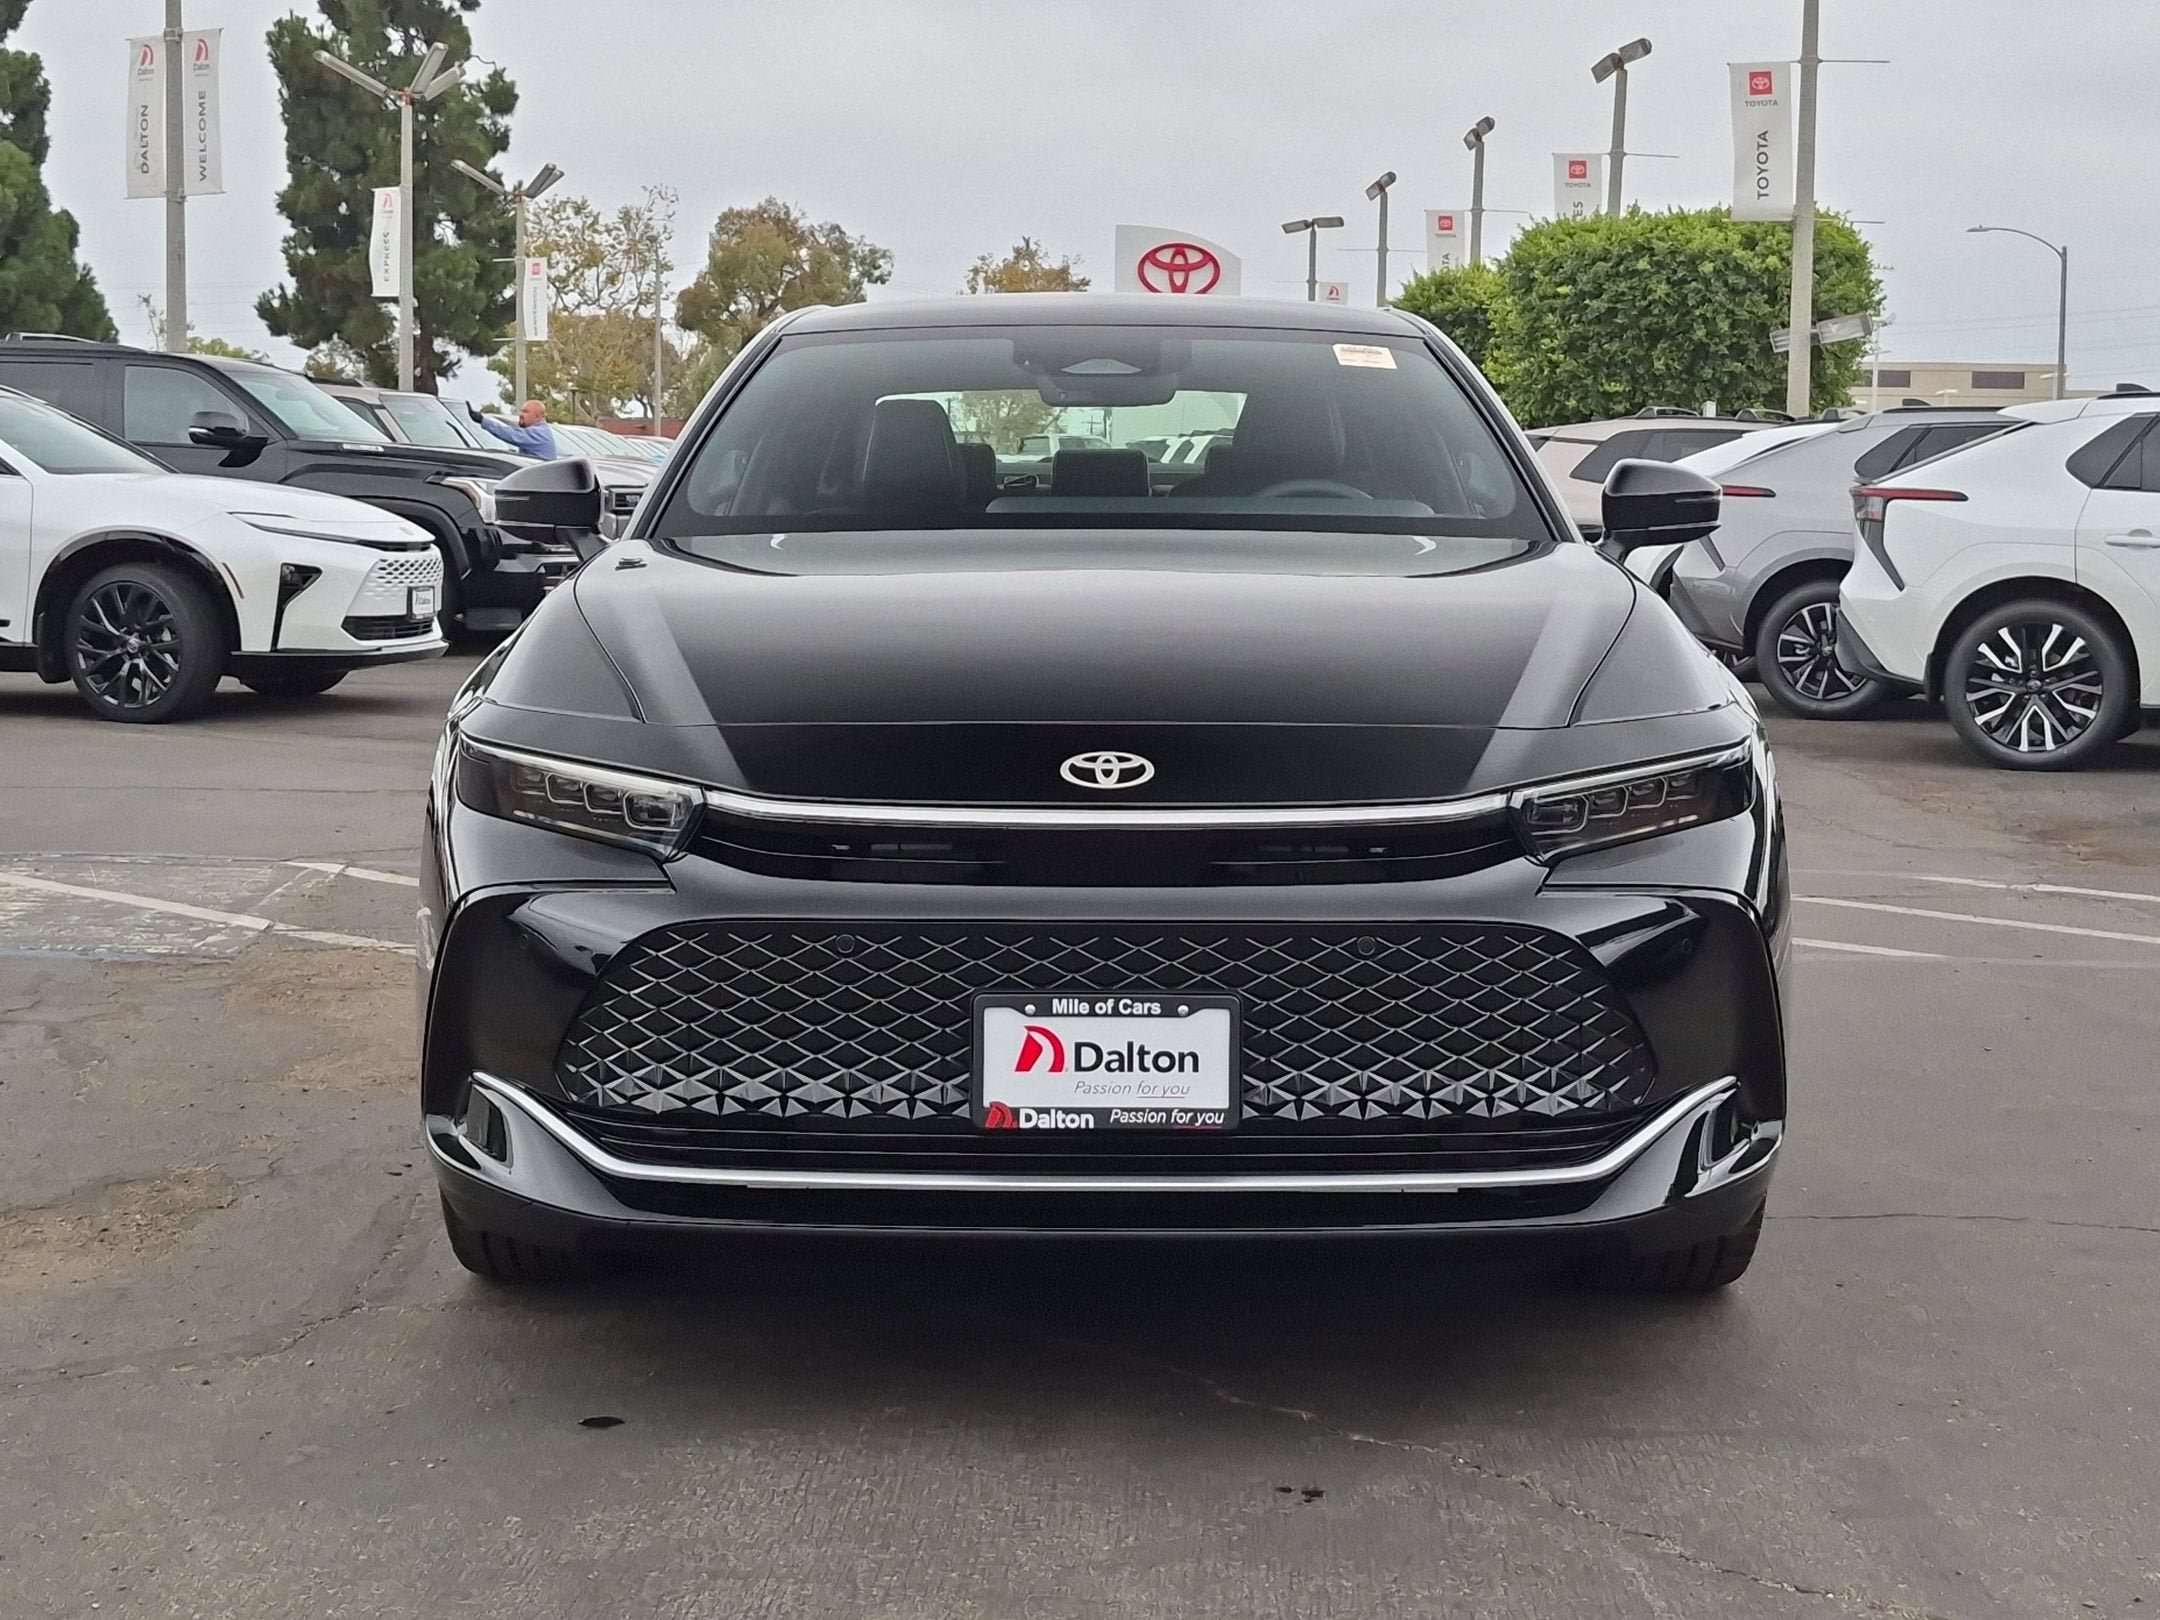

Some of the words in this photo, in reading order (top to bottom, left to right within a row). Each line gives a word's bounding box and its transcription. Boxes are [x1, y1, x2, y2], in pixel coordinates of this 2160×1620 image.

[1744, 99, 1779, 108] TOYOTA
[140, 104, 150, 175] DALTON
[198, 90, 208, 182] WELCOME
[1756, 130, 1770, 201] TOYOTA
[1052, 998, 1090, 1015] Mile
[1095, 998, 1115, 1015] of
[1118, 998, 1162, 1015] Cars
[1073, 1041, 1200, 1073] Dalton
[1073, 1080, 1132, 1096] Passion
[1136, 1080, 1159, 1096] for
[1160, 1084, 1191, 1097] you
[1018, 1108, 1095, 1129] Dalton
[1109, 1109, 1168, 1124] Passion
[1169, 1109, 1194, 1125] for
[1193, 1112, 1225, 1128] you
